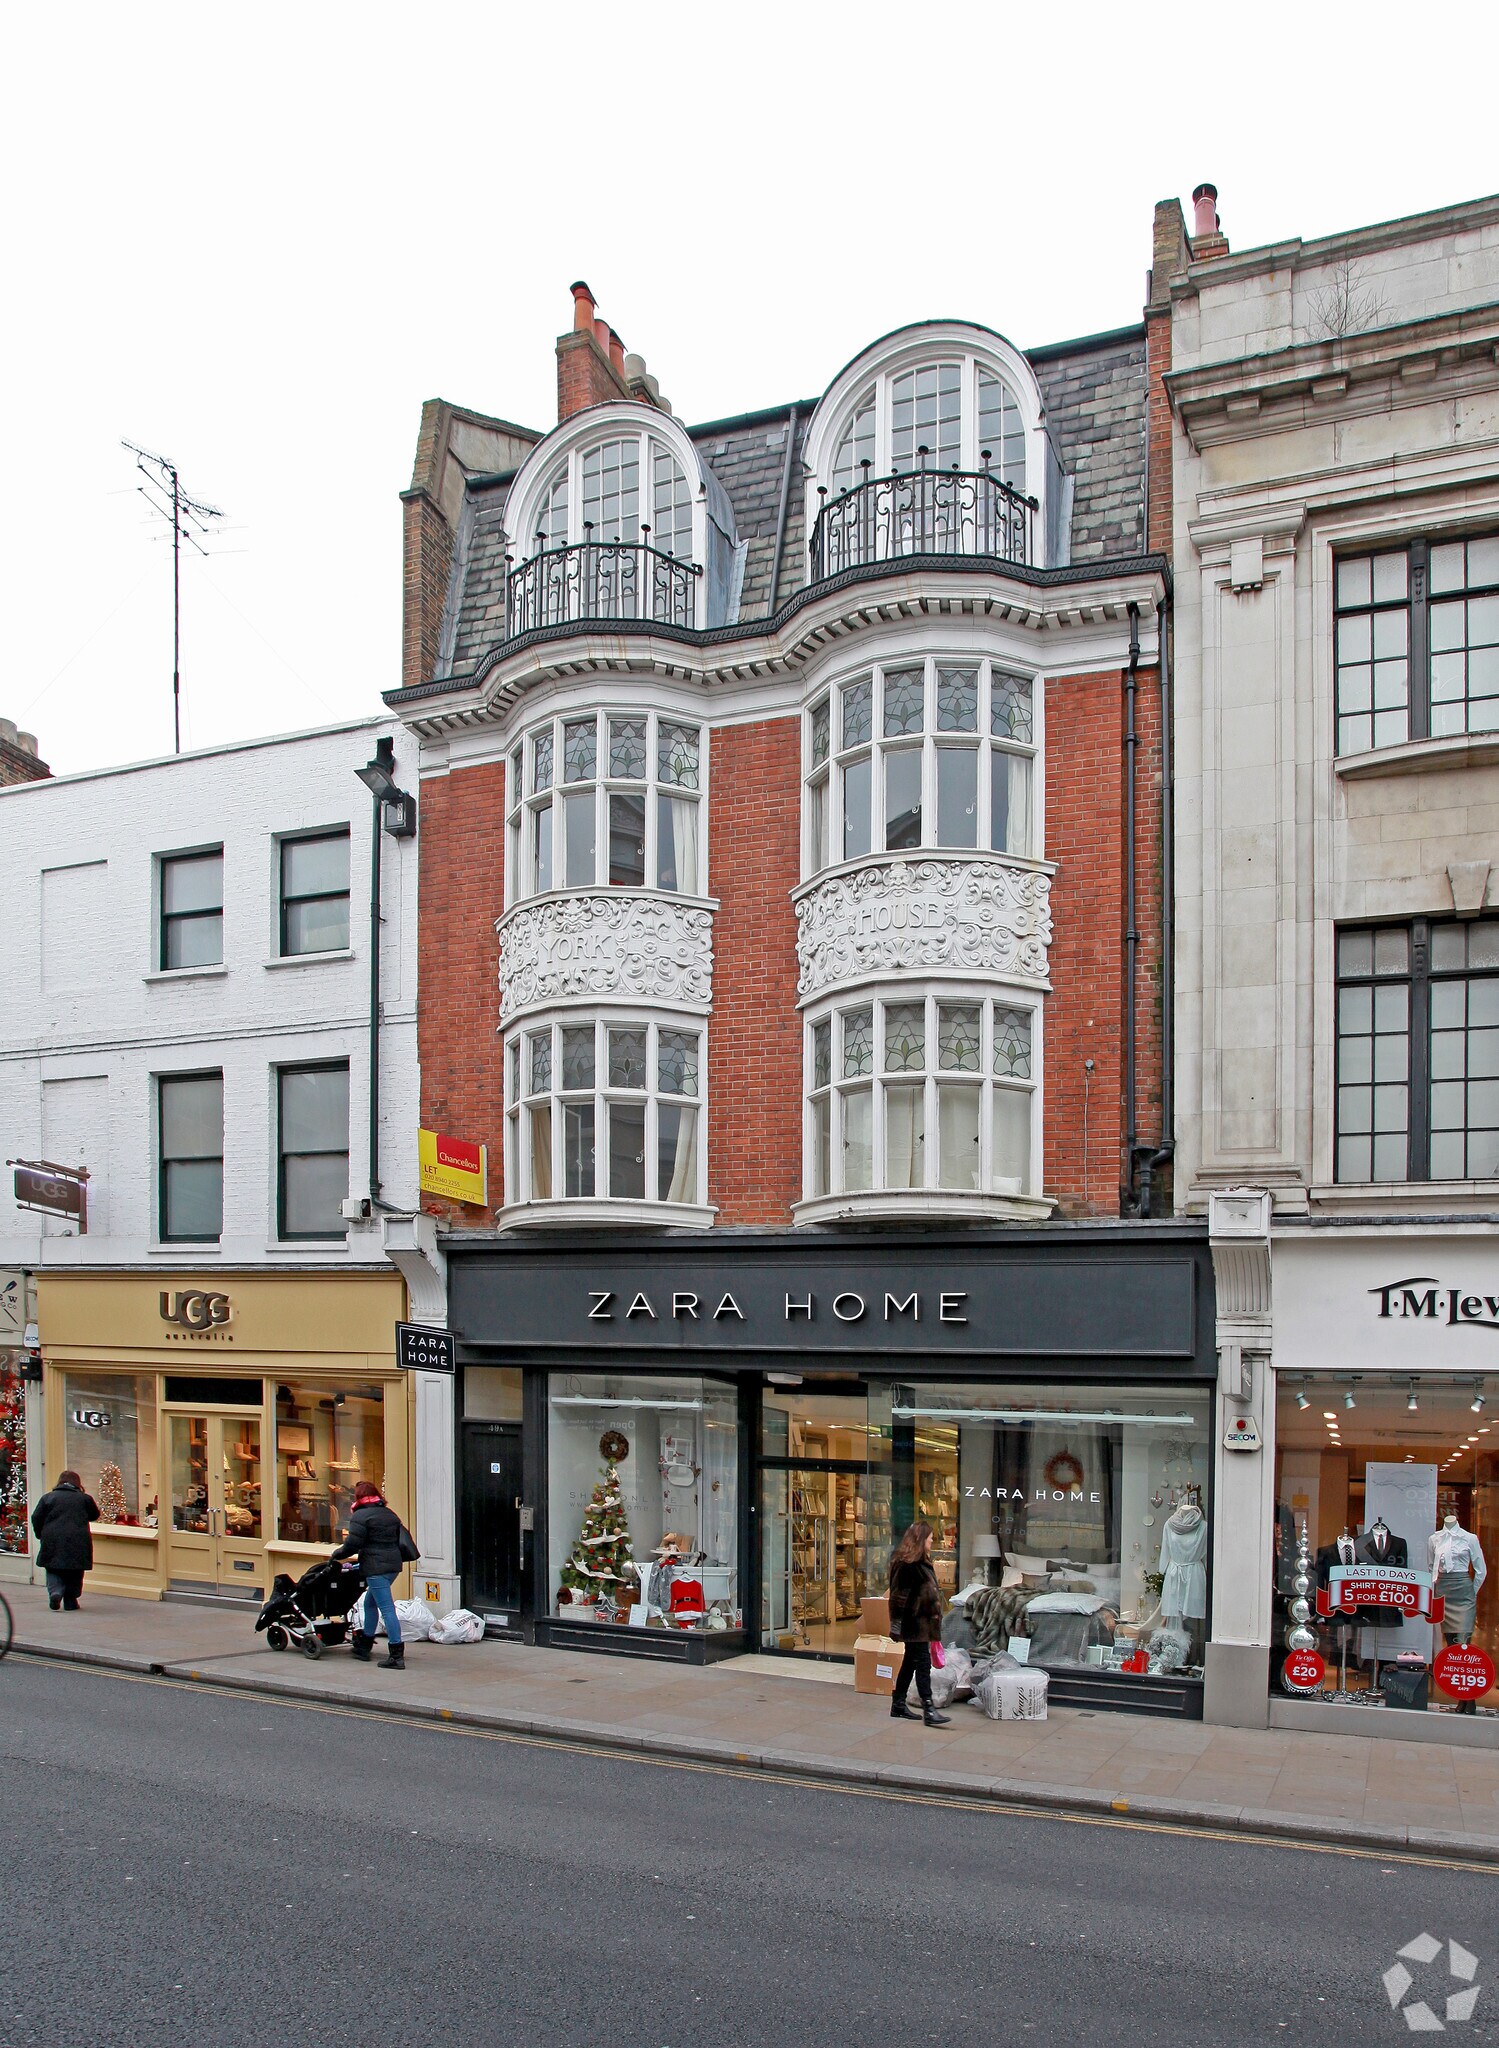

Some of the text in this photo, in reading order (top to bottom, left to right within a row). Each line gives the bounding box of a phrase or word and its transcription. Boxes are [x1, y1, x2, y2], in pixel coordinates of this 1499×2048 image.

[859, 903, 945, 935] HOUSE
[541, 934, 612, 964] YORK
[440, 1151, 478, 1170] Chancellors
[424, 1164, 438, 1175] LET
[32, 1177, 68, 1198] UGG
[159, 1289, 231, 1331] UGG
[588, 1292, 970, 1322] ZARA HOME
[165, 1333, 234, 1341] australia
[408, 1335, 447, 1350] ZARA
[408, 1351, 448, 1366] HOME
[965, 1486, 1101, 1503] ZARA HOME
[1346, 1568, 1416, 1581] LAST 10 DAYS
[1378, 1582, 1409, 1592] OFFER
[1344, 1589, 1415, 1605] 5 FOR £100
[1463, 1654, 1482, 1664] Offer
[1292, 1666, 1317, 1677] £20
[1466, 1667, 1486, 1675] SUITS
[1450, 1673, 1487, 1687] £199
